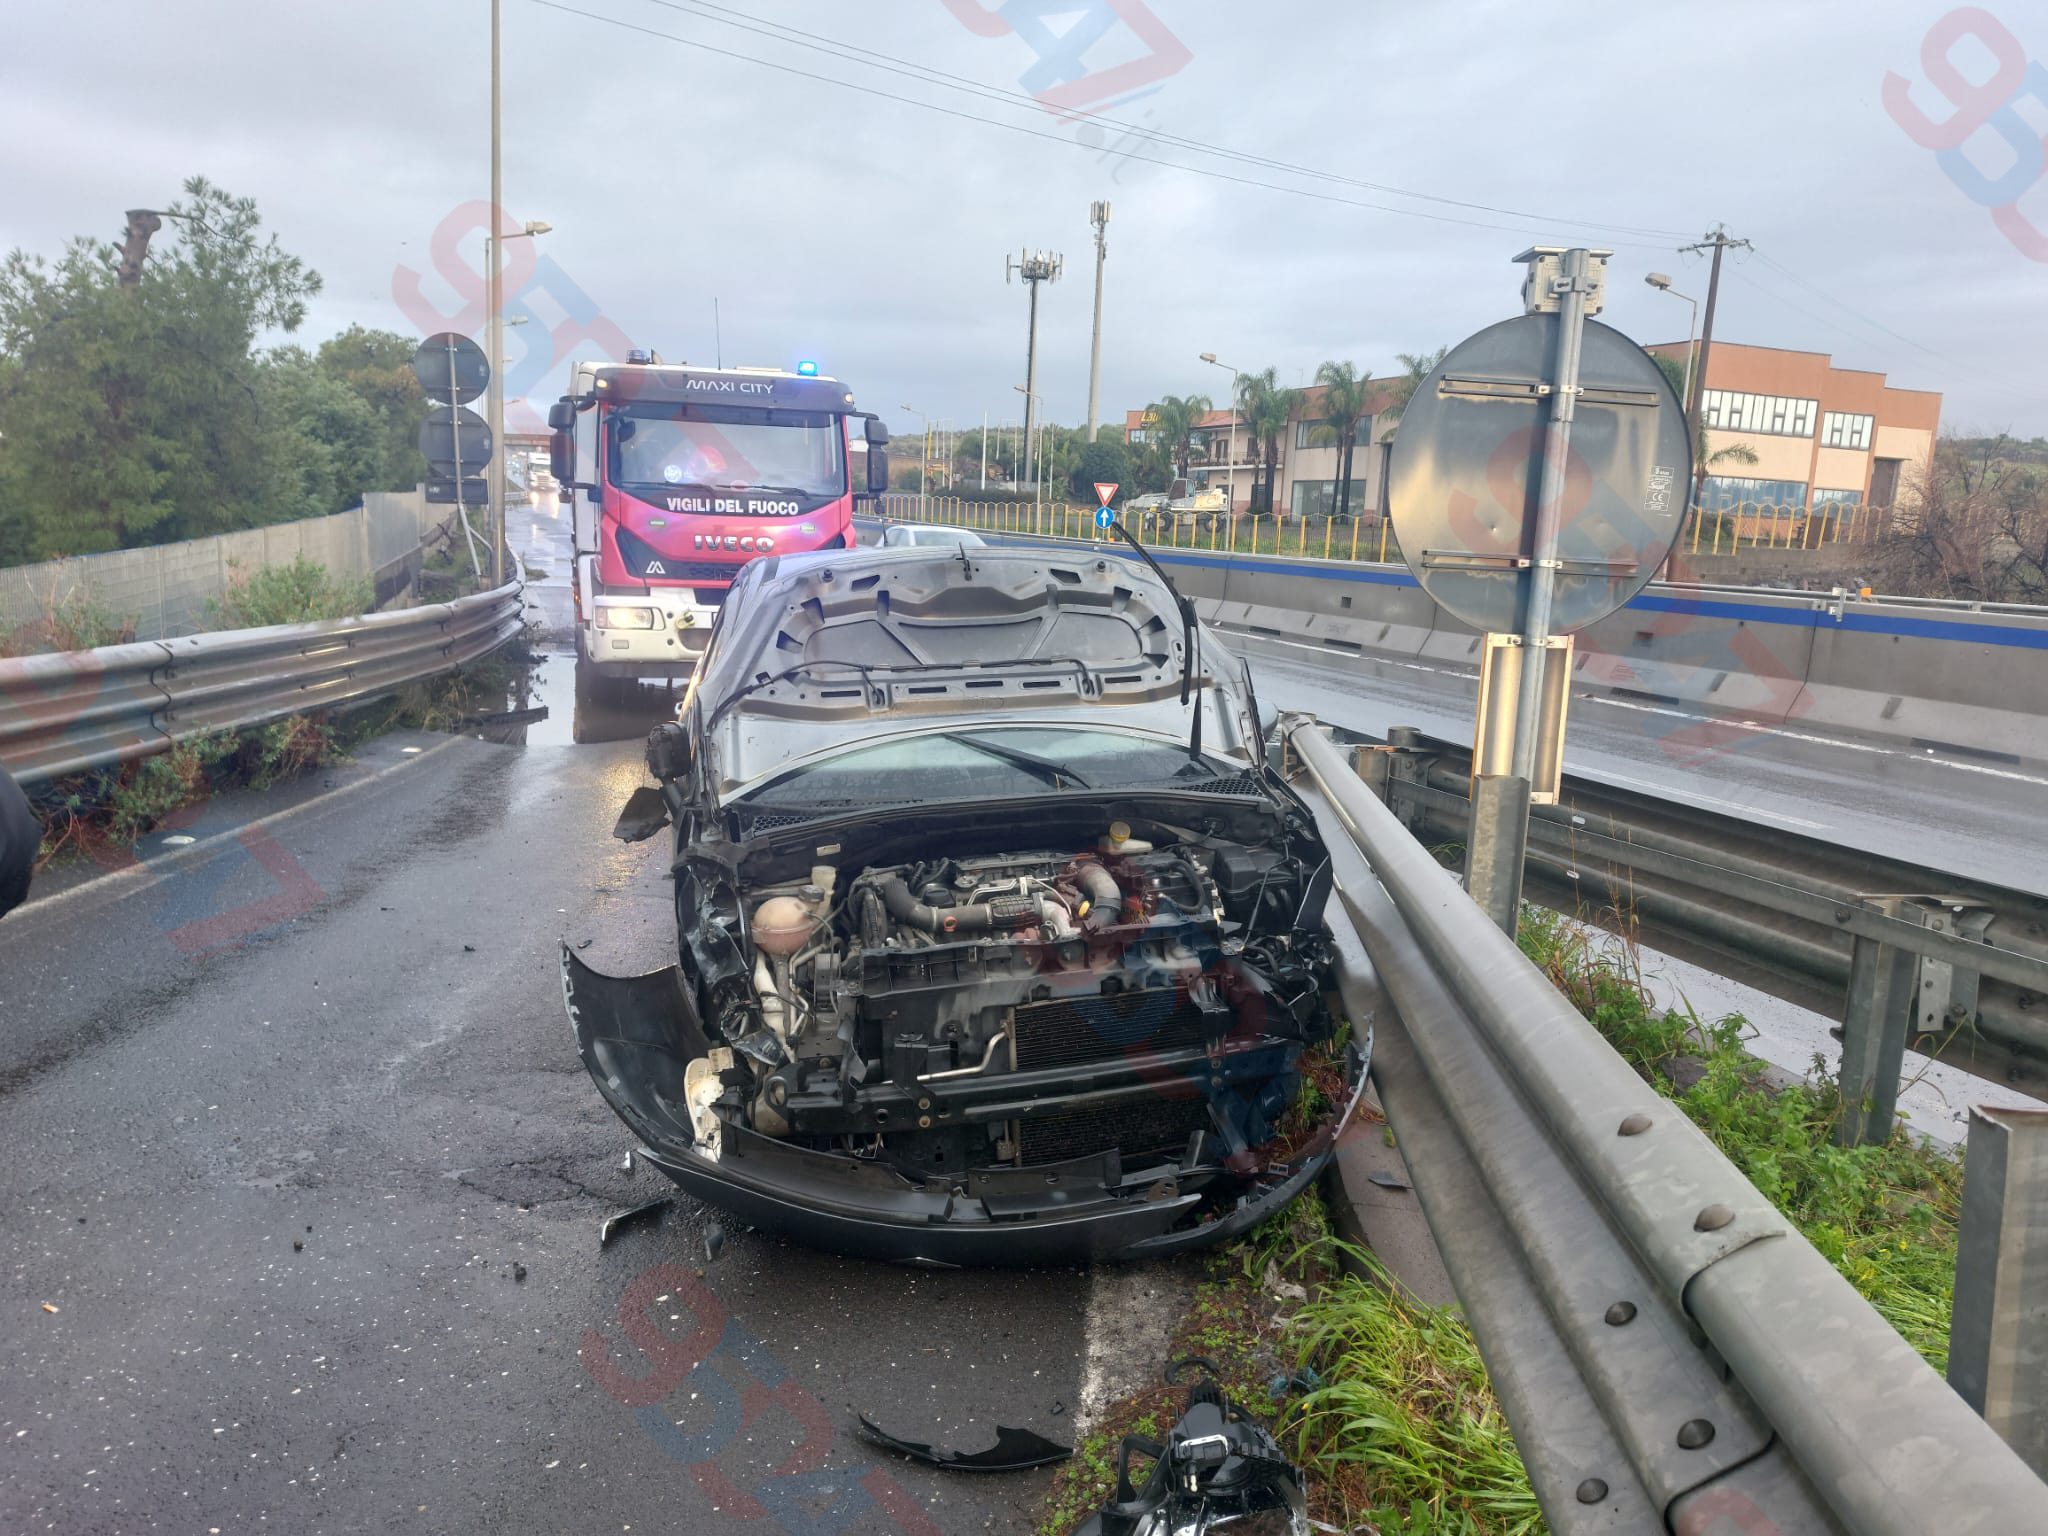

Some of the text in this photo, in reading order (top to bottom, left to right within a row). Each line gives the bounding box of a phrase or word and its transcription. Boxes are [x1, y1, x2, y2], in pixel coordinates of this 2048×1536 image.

[686, 379, 774, 395] MAXI CITY
[667, 497, 799, 516] VIGILI DEL FUOCO
[694, 534, 775, 553] IVECO
